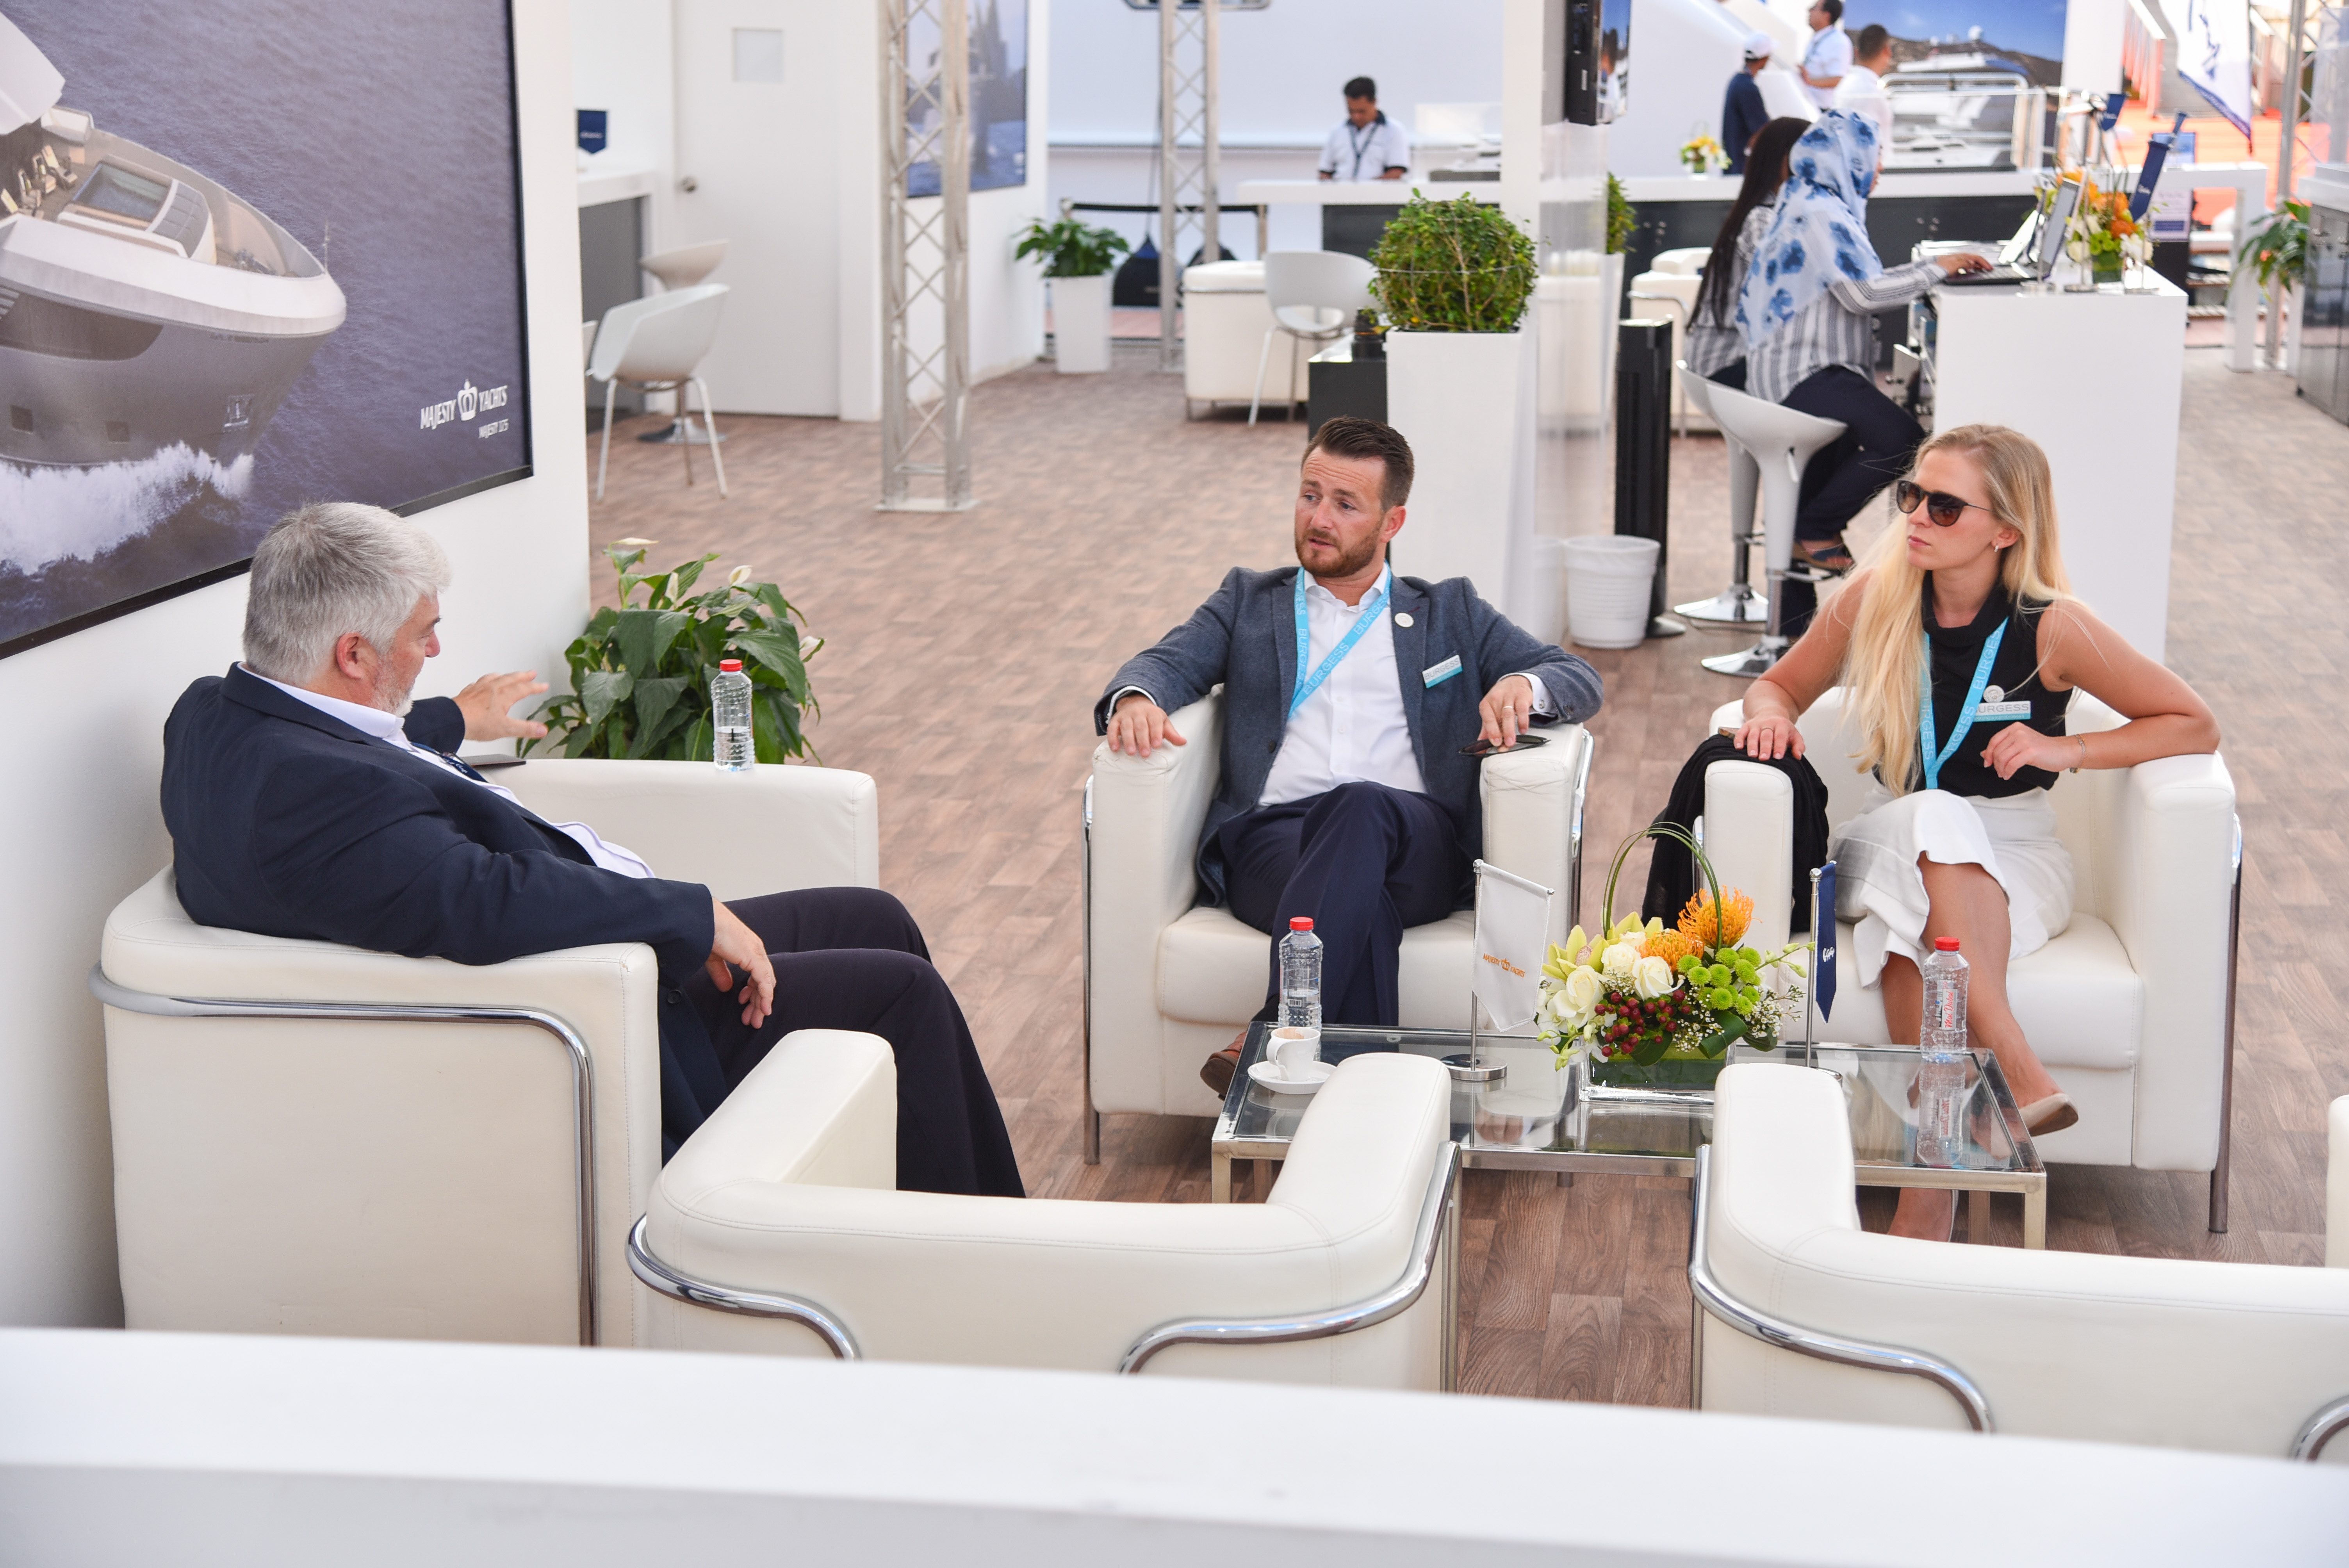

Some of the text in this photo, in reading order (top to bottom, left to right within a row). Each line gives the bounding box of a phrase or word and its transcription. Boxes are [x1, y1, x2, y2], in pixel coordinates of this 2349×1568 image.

[420, 385, 508, 429] MAJESTY YACHTS
[1973, 624, 2002, 690] BURGES
[1303, 643, 1349, 695] BURGESS
[1424, 658, 1459, 680] BURGESS
[1976, 704, 2029, 713] URGESS
[1483, 953, 1525, 978] MAJESTY YACHTS
[1944, 991, 1954, 1012] Dubai
[1944, 1012, 1953, 1028] Mai
